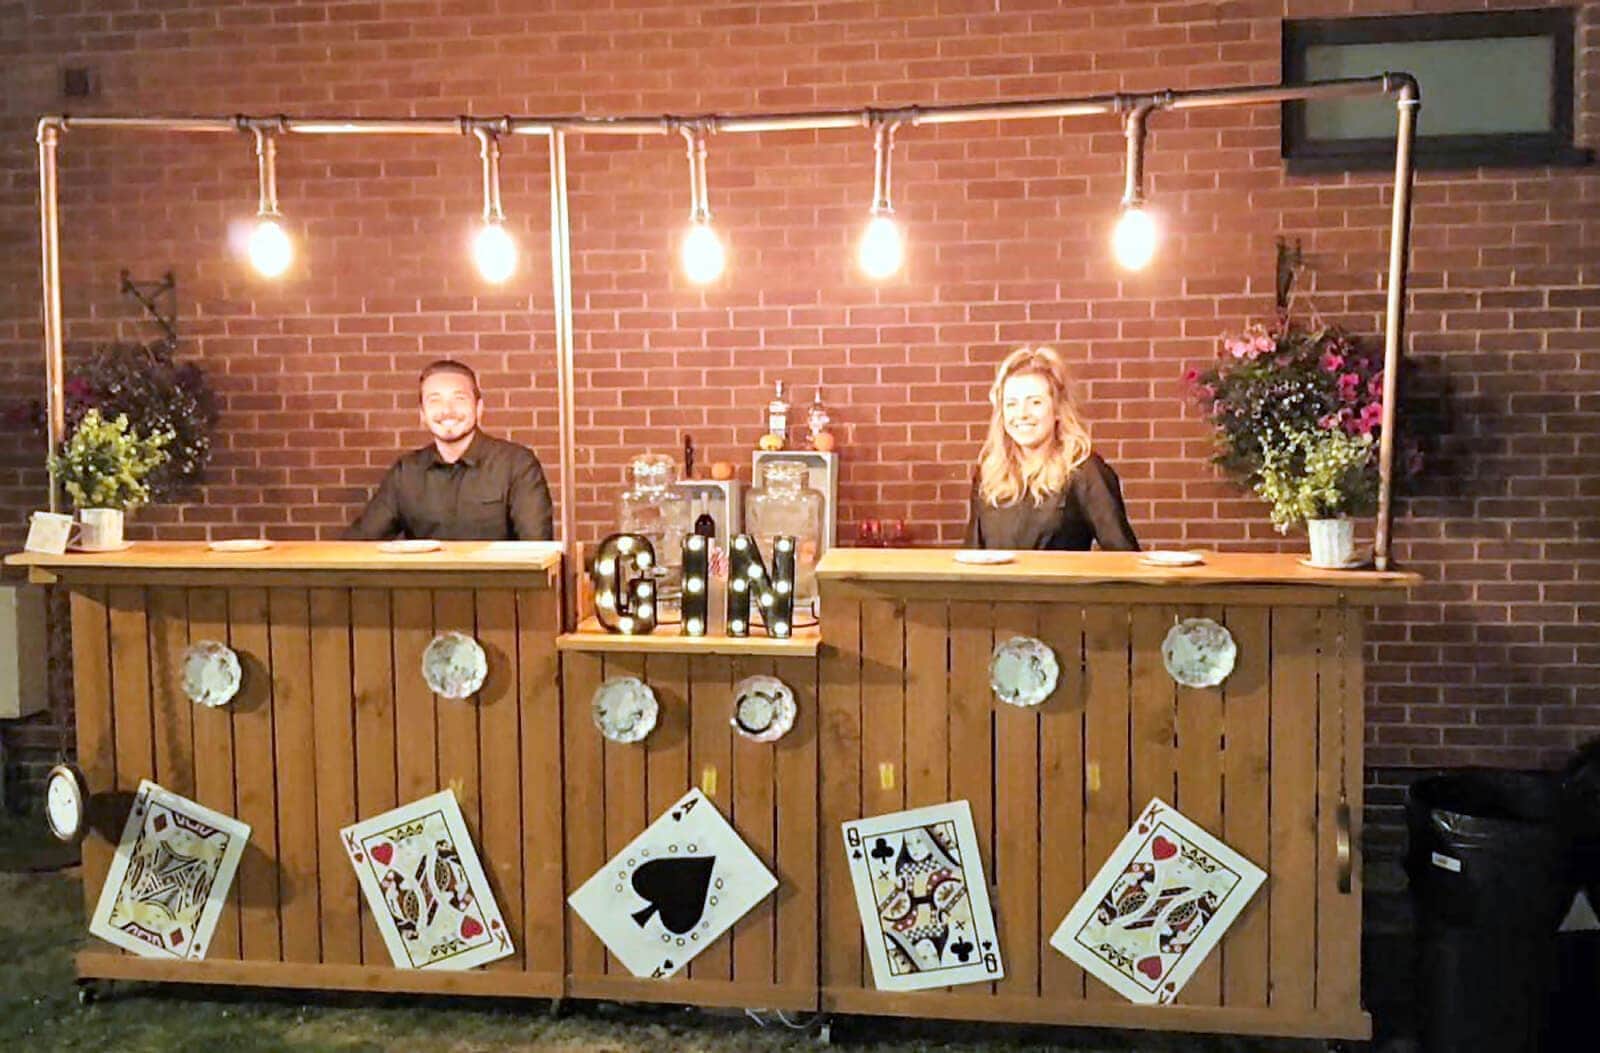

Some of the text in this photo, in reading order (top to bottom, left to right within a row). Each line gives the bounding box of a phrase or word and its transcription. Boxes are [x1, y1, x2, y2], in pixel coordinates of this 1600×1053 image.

[592, 533, 796, 638] GIN
[681, 798, 699, 815] A
[1144, 803, 1164, 827] K
[345, 830, 361, 852] K
[847, 827, 861, 847] Q
[495, 929, 510, 952] K
